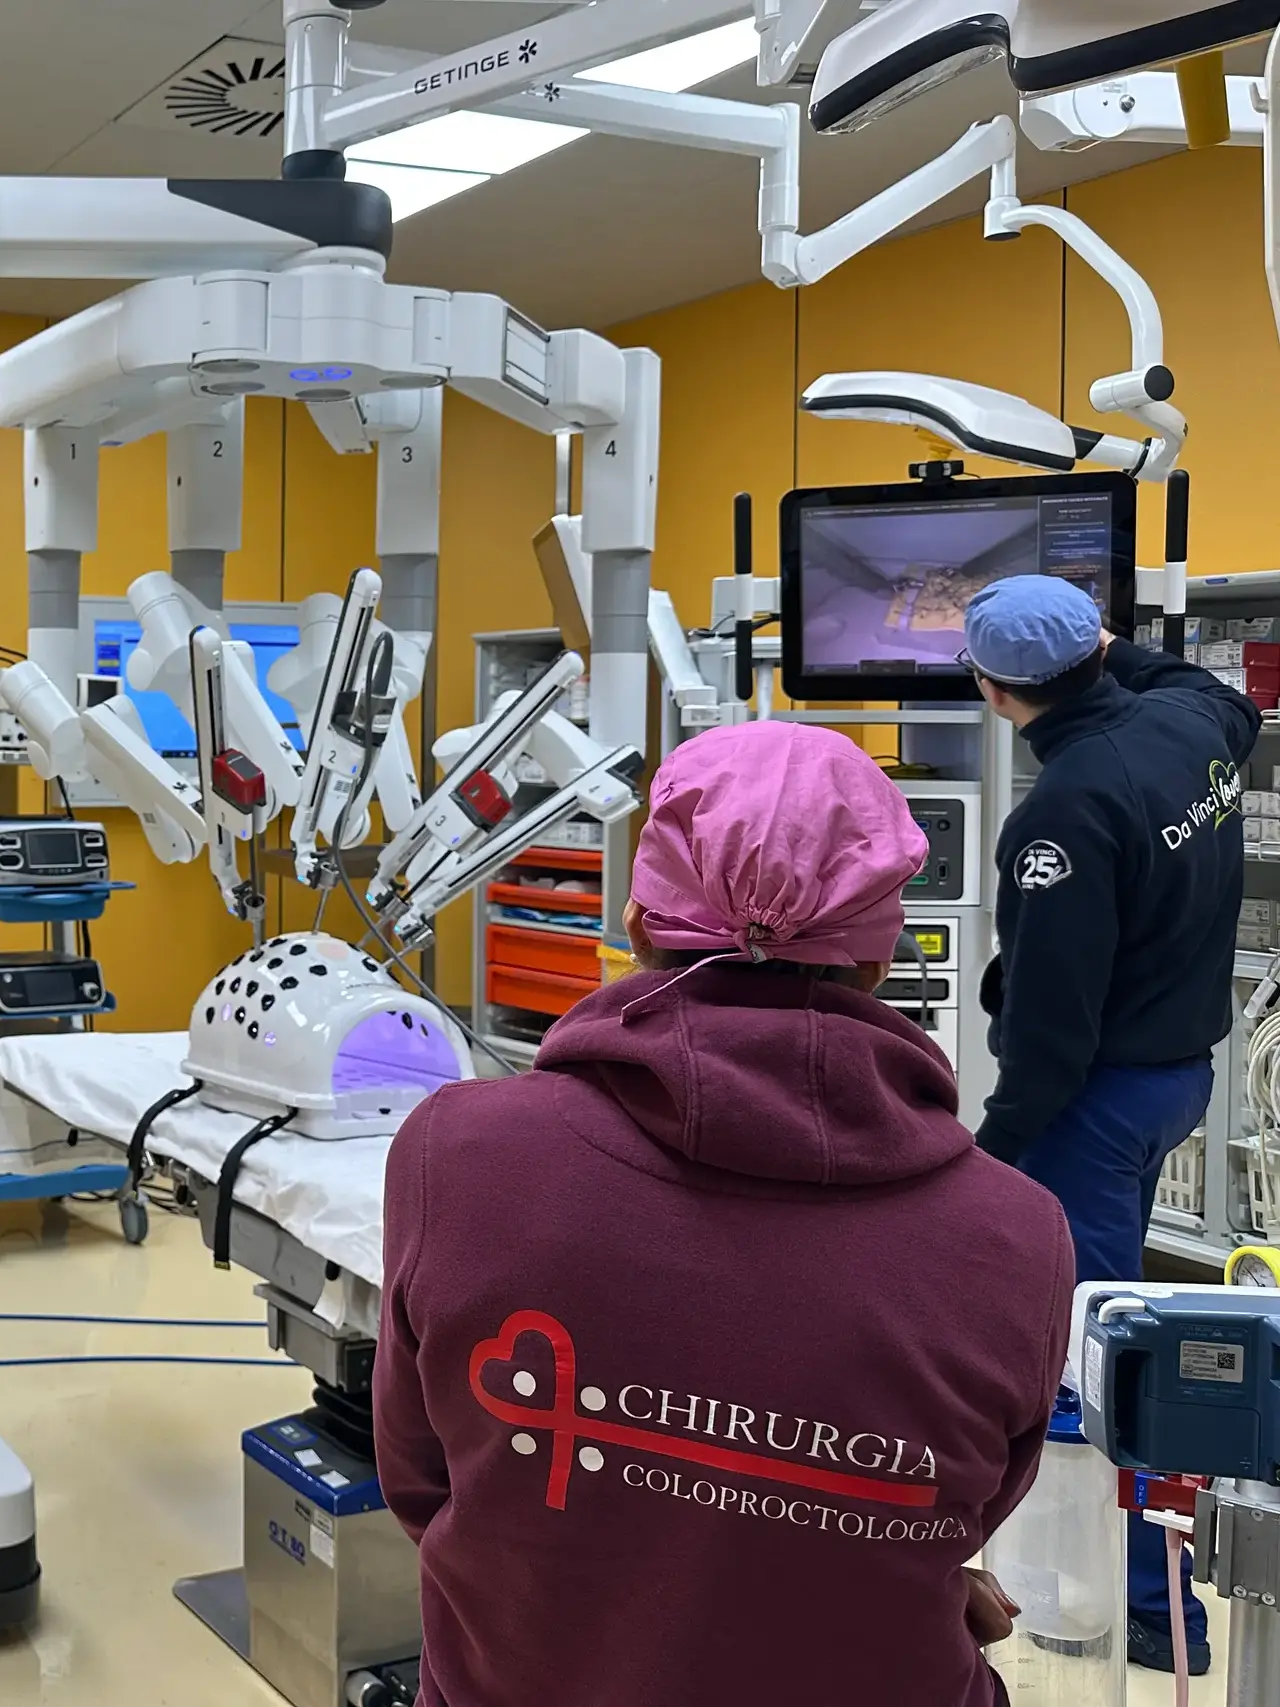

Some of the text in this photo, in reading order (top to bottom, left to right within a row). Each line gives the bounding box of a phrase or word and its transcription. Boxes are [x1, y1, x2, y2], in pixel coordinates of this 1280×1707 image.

[414, 50, 510, 95] GETINGE
[71, 443, 76, 460] 1
[213, 440, 223, 458] 2
[402, 446, 413, 463] 3
[605, 440, 617, 457] 4
[328, 750, 337, 764] 2
[434, 815, 447, 827] 3
[1161, 820, 1192, 850] Da
[1186, 787, 1220, 827] Vinci
[1021, 855, 1058, 886] 25
[618, 1384, 938, 1479] CHIRURGIA
[622, 1463, 968, 1541] COLOPROCTOLOGICA
